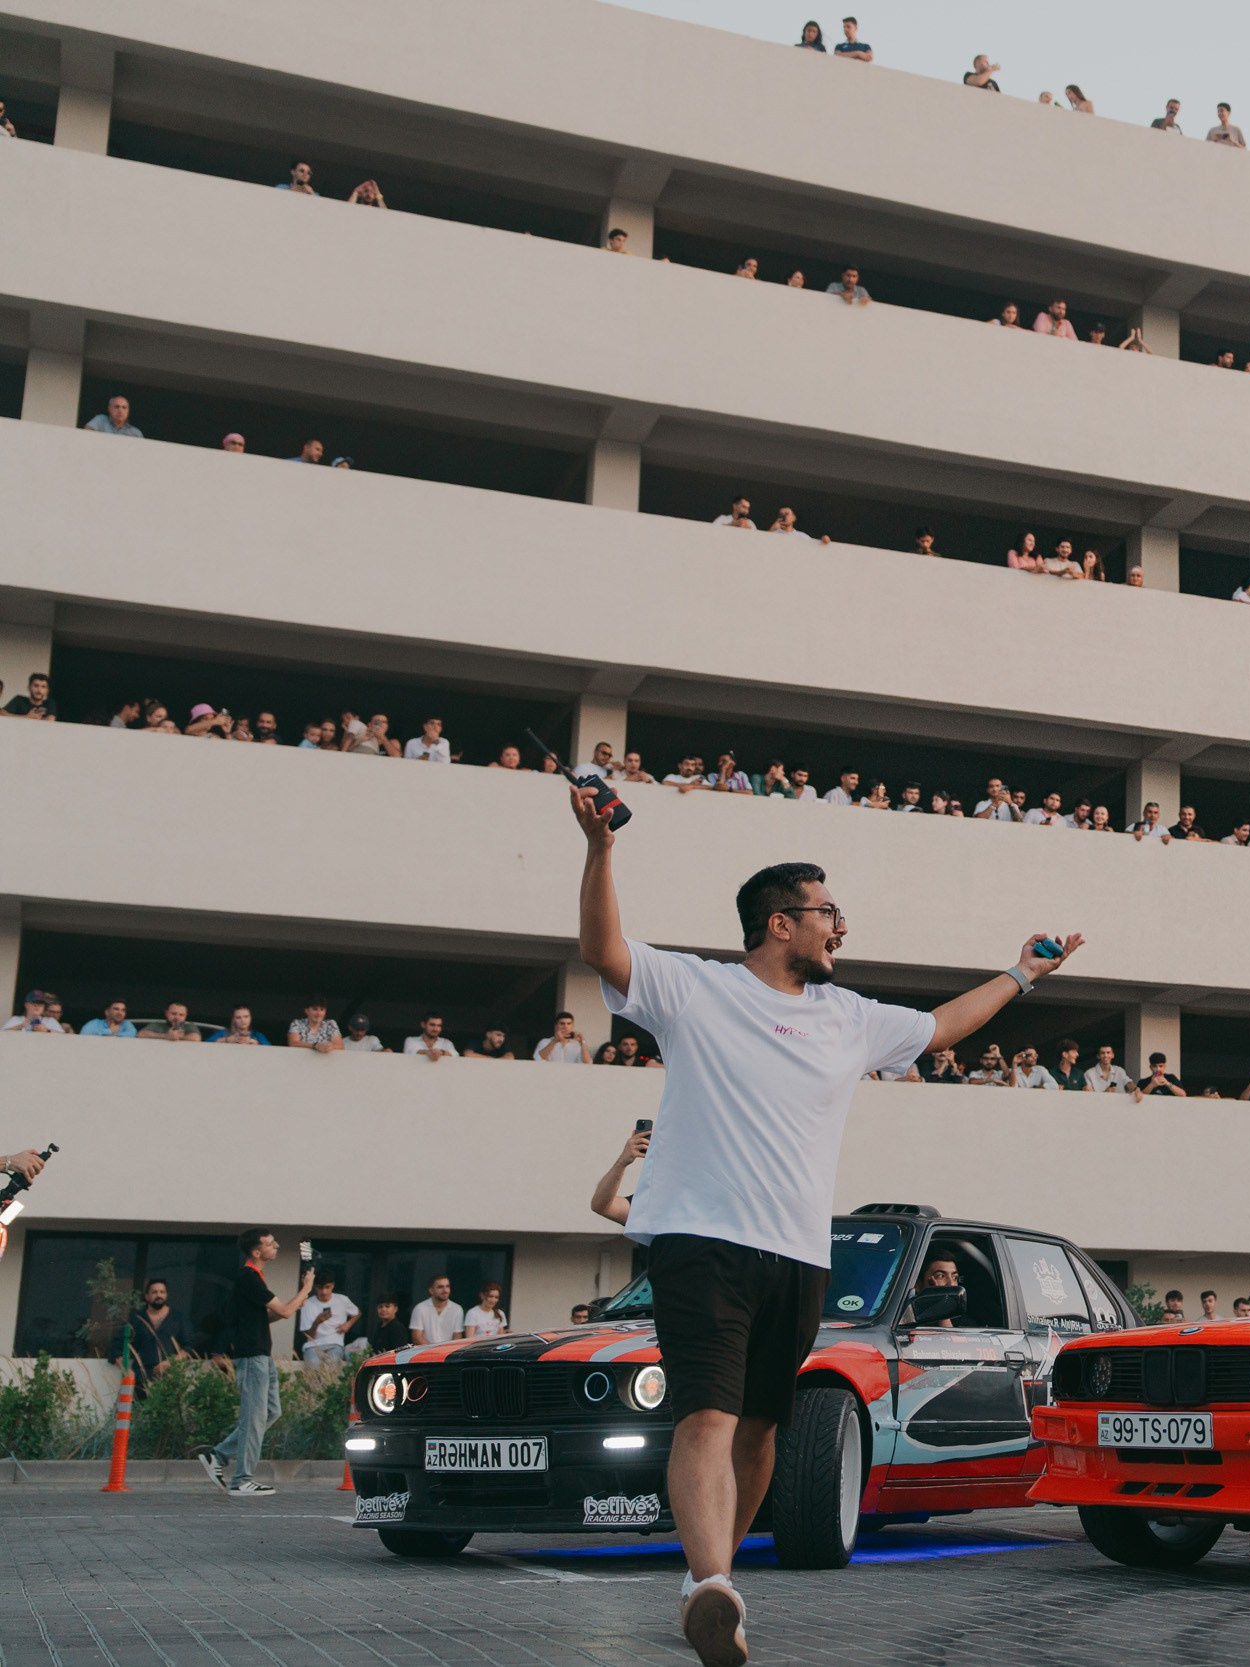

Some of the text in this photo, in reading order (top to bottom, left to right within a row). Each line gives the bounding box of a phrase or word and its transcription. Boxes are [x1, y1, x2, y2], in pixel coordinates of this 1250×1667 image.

[1101, 1417, 1206, 1444] AZ 99-TS-079
[427, 1442, 543, 1467] AZ RƏHMAN 007
[358, 1496, 397, 1512] betlive
[586, 1497, 647, 1515] betlive
[358, 1511, 403, 1520] RACING SEASON
[619, 1514, 656, 1522] SEASON
